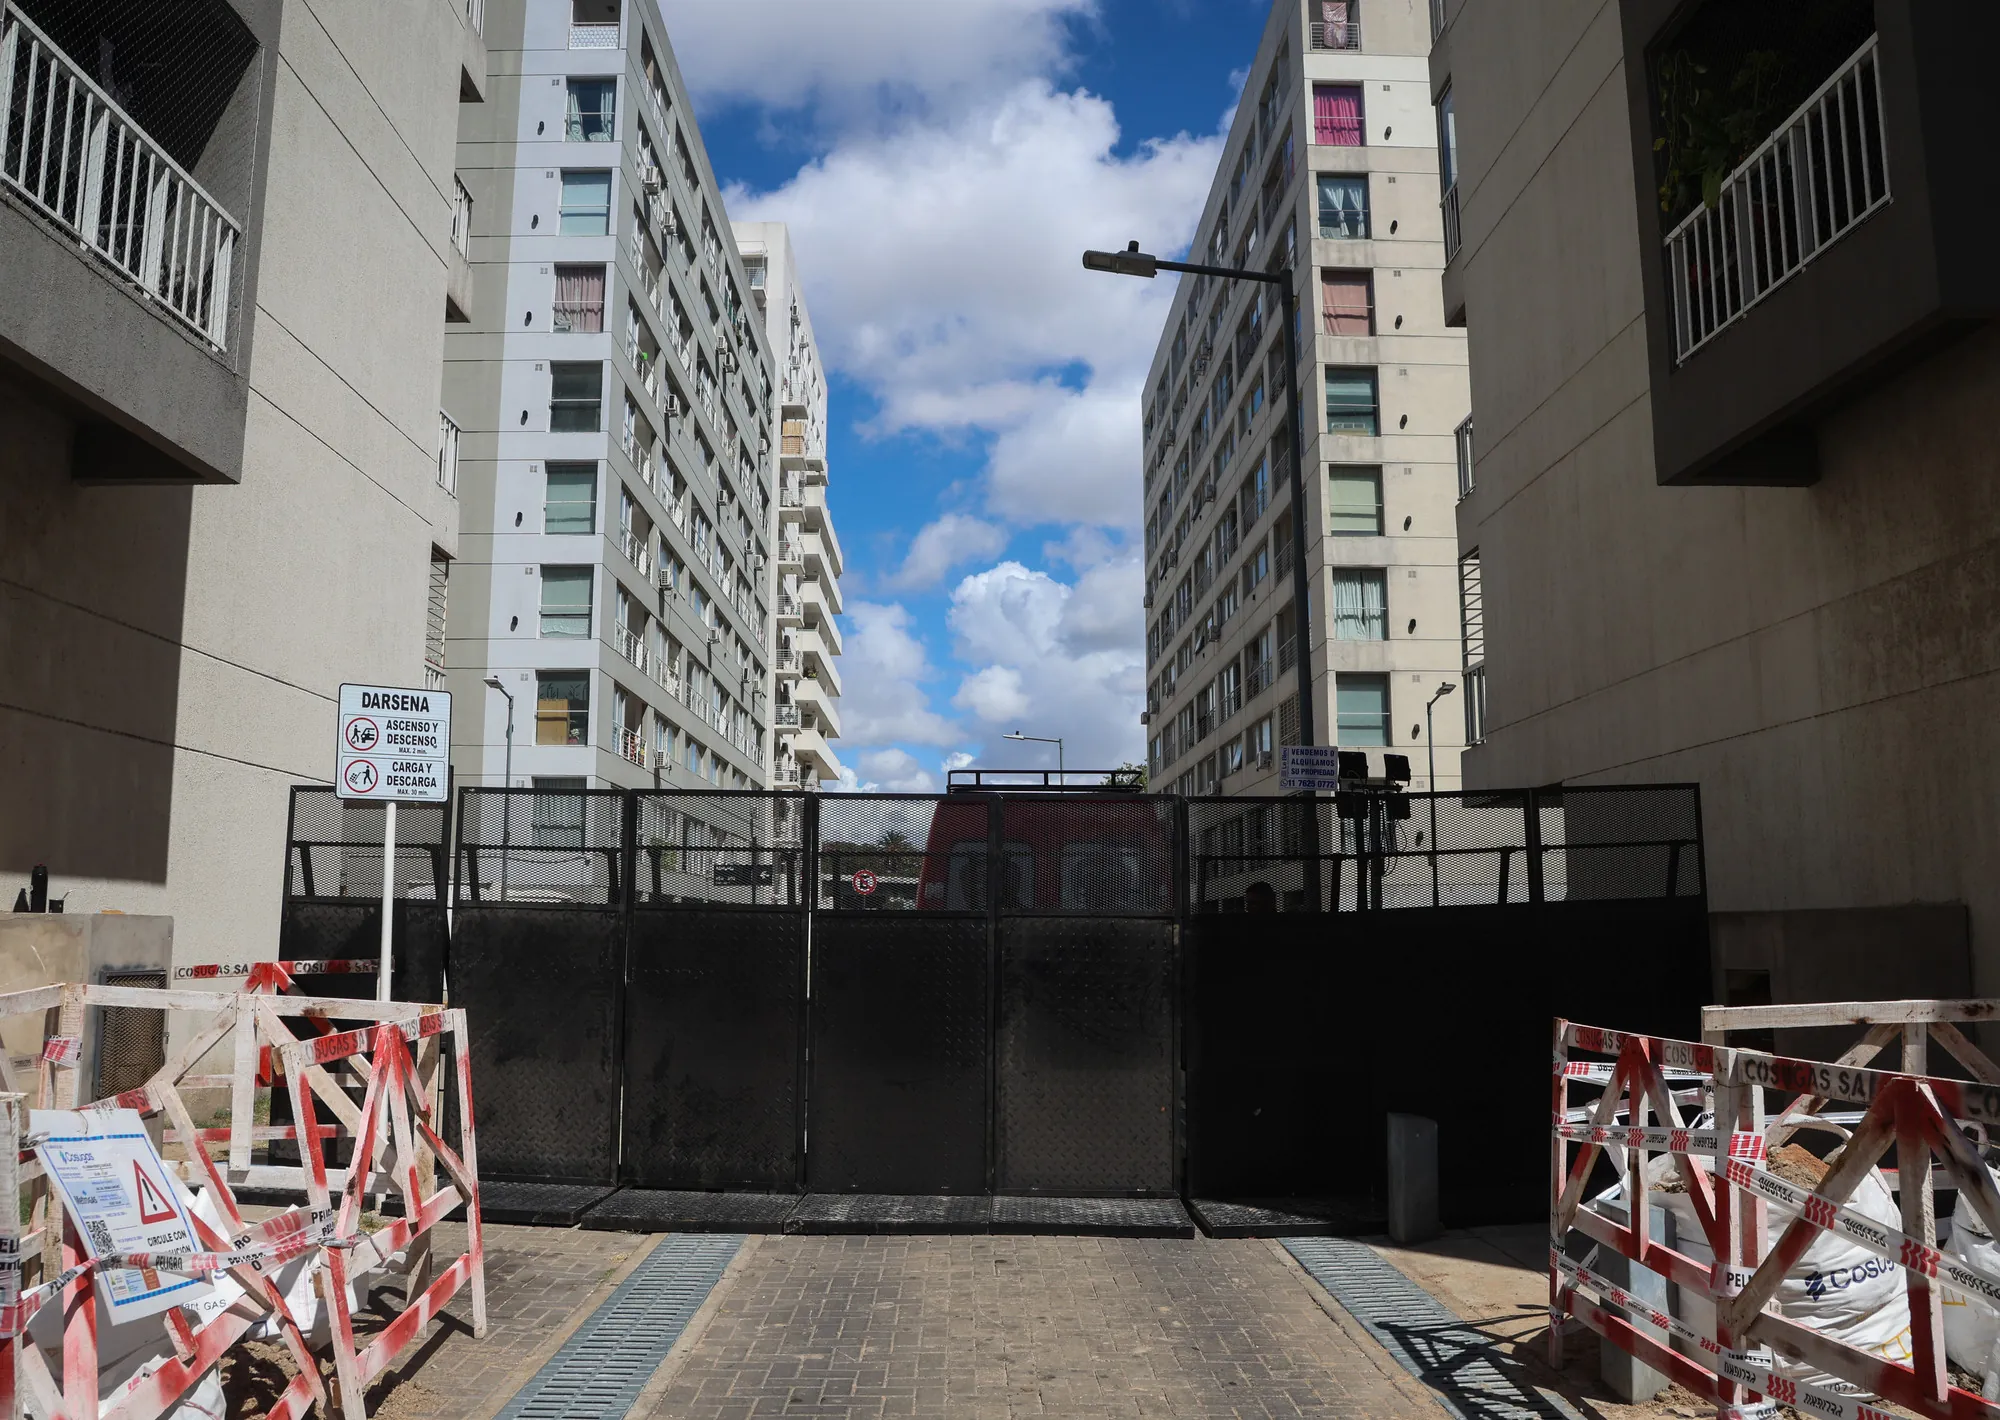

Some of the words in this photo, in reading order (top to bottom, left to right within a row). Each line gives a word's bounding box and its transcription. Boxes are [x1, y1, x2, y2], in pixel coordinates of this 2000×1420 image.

[361, 692, 430, 713] DARSENA
[386, 720, 430, 733] ASCENSO
[432, 723, 439, 733] Y
[387, 734, 437, 747] DESCENSO
[1291, 748, 1328, 757] VENDEMOS
[392, 761, 424, 774] CARGA
[426, 763, 432, 774] Y
[1291, 758, 1335, 767] ALQUILAMOS
[1301, 768, 1335, 776] PROPIEDAD
[386, 775, 437, 788] DESCARGA
[1317, 780, 1335, 788] 0772
[177, 964, 230, 978] COSUGAS
[232, 963, 249, 974] SA
[1574, 1028, 1614, 1049] COSUGAS
[1744, 1058, 1831, 1093] COSUGAS
[1758, 1176, 1795, 1204] PELIGRO
[147, 1233, 173, 1247] CIRCULE
[173, 1229, 187, 1241] CON
[1842, 1217, 1887, 1247] PELIGRO
[155, 1255, 183, 1271] PELIGRO
[203, 1298, 227, 1311] GAS
